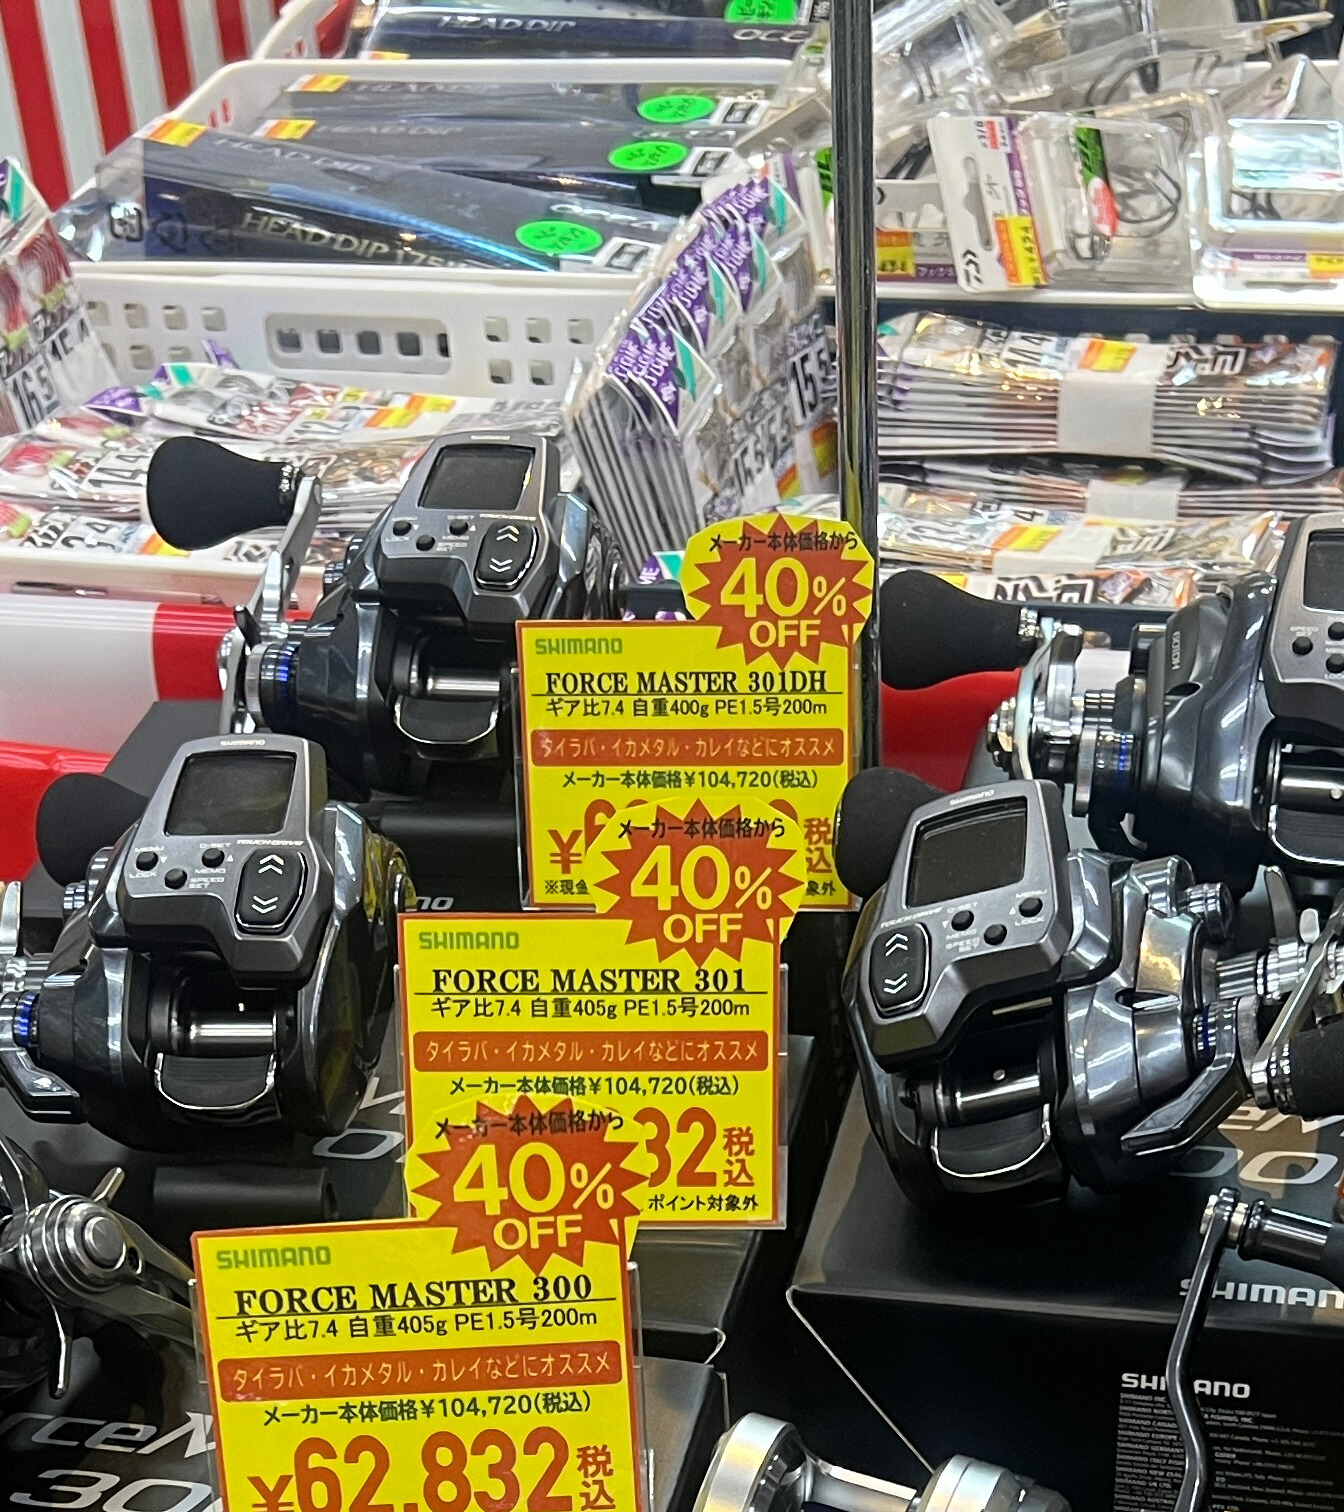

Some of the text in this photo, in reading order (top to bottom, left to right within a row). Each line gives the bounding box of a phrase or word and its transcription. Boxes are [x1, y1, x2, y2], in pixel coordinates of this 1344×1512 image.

[334, 233, 390, 259] DIP
[709, 530, 857, 552] メーカー本体価格から
[720, 556, 847, 618] 40%
[535, 638, 623, 655] SHIMANO
[749, 620, 820, 647] OFF
[545, 671, 827, 693] FORCE MASTER 301DH
[545, 698, 827, 718] ギア比7.4 自重400g PE1.5号200m
[618, 817, 786, 839] メーカー本体価格から
[630, 845, 772, 910] 40%
[419, 932, 519, 950] SHIMANO
[664, 913, 742, 943] OFF
[432, 969, 746, 992] FORCE MASTER 301
[431, 997, 749, 1019] ギア比7.4 自重405g PE1.5号200m
[723, 1127, 755, 1188] 税込
[453, 1142, 614, 1215] 40%
[493, 1215, 582, 1249] OFF
[217, 1246, 331, 1269] SHIMANO
[234, 1275, 592, 1316] FORCE MASTER 300
[235, 1310, 598, 1344] ギア比7.4 自重405g PE1.5号200m
[578, 1444, 615, 1512] 税込
